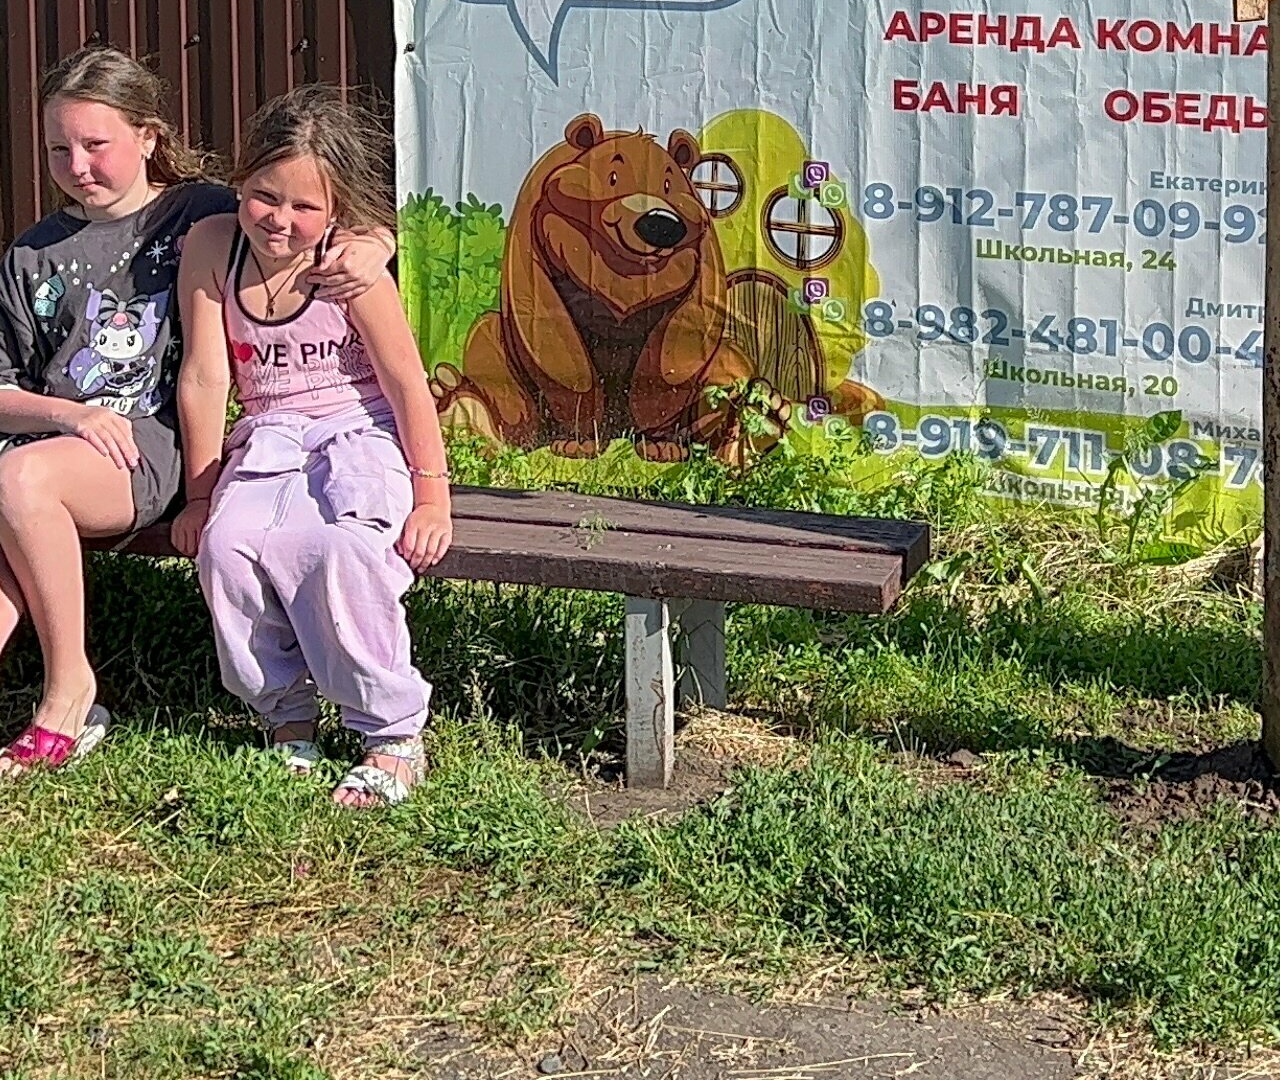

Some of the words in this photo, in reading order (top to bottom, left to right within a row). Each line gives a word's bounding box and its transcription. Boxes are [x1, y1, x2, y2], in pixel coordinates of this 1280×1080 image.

[883, 10, 1082, 53] АРЕНДА
[1097, 18, 1269, 56] КОМНА
[893, 79, 1018, 117] БАНЯ
[1150, 170, 1266, 198] Екатери
[863, 181, 1267, 245] 8-912-787-09-9
[975, 238, 1133, 273] Школьная,
[1140, 249, 1177, 272] 24
[1185, 297, 1265, 324] Дмит
[300, 333, 365, 366] PINK
[863, 300, 1264, 369] 8-982-481-00-4
[985, 358, 1136, 396] Школьная,
[1143, 374, 1179, 397] 20
[1192, 420, 1261, 441] Миха
[865, 414, 1264, 486] 8-919-711-08-7
